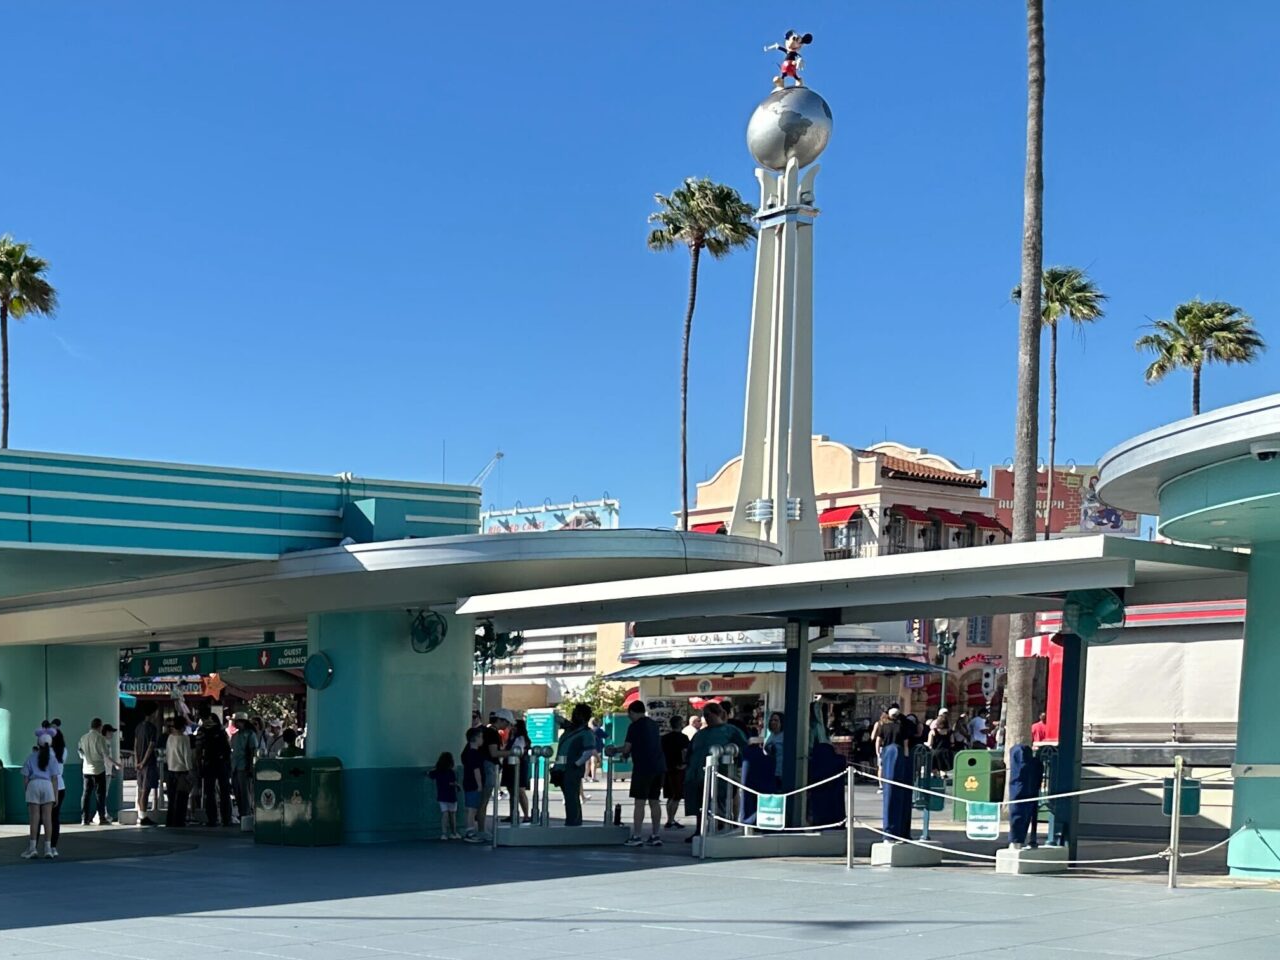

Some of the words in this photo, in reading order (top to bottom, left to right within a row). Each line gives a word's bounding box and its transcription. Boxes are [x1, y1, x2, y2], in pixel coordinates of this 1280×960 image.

[998, 500, 1065, 509] AURAPH
[687, 632, 745, 643] WORLD
[283, 648, 303, 656] GUEST
[278, 656, 307, 665] ENTRANCE
